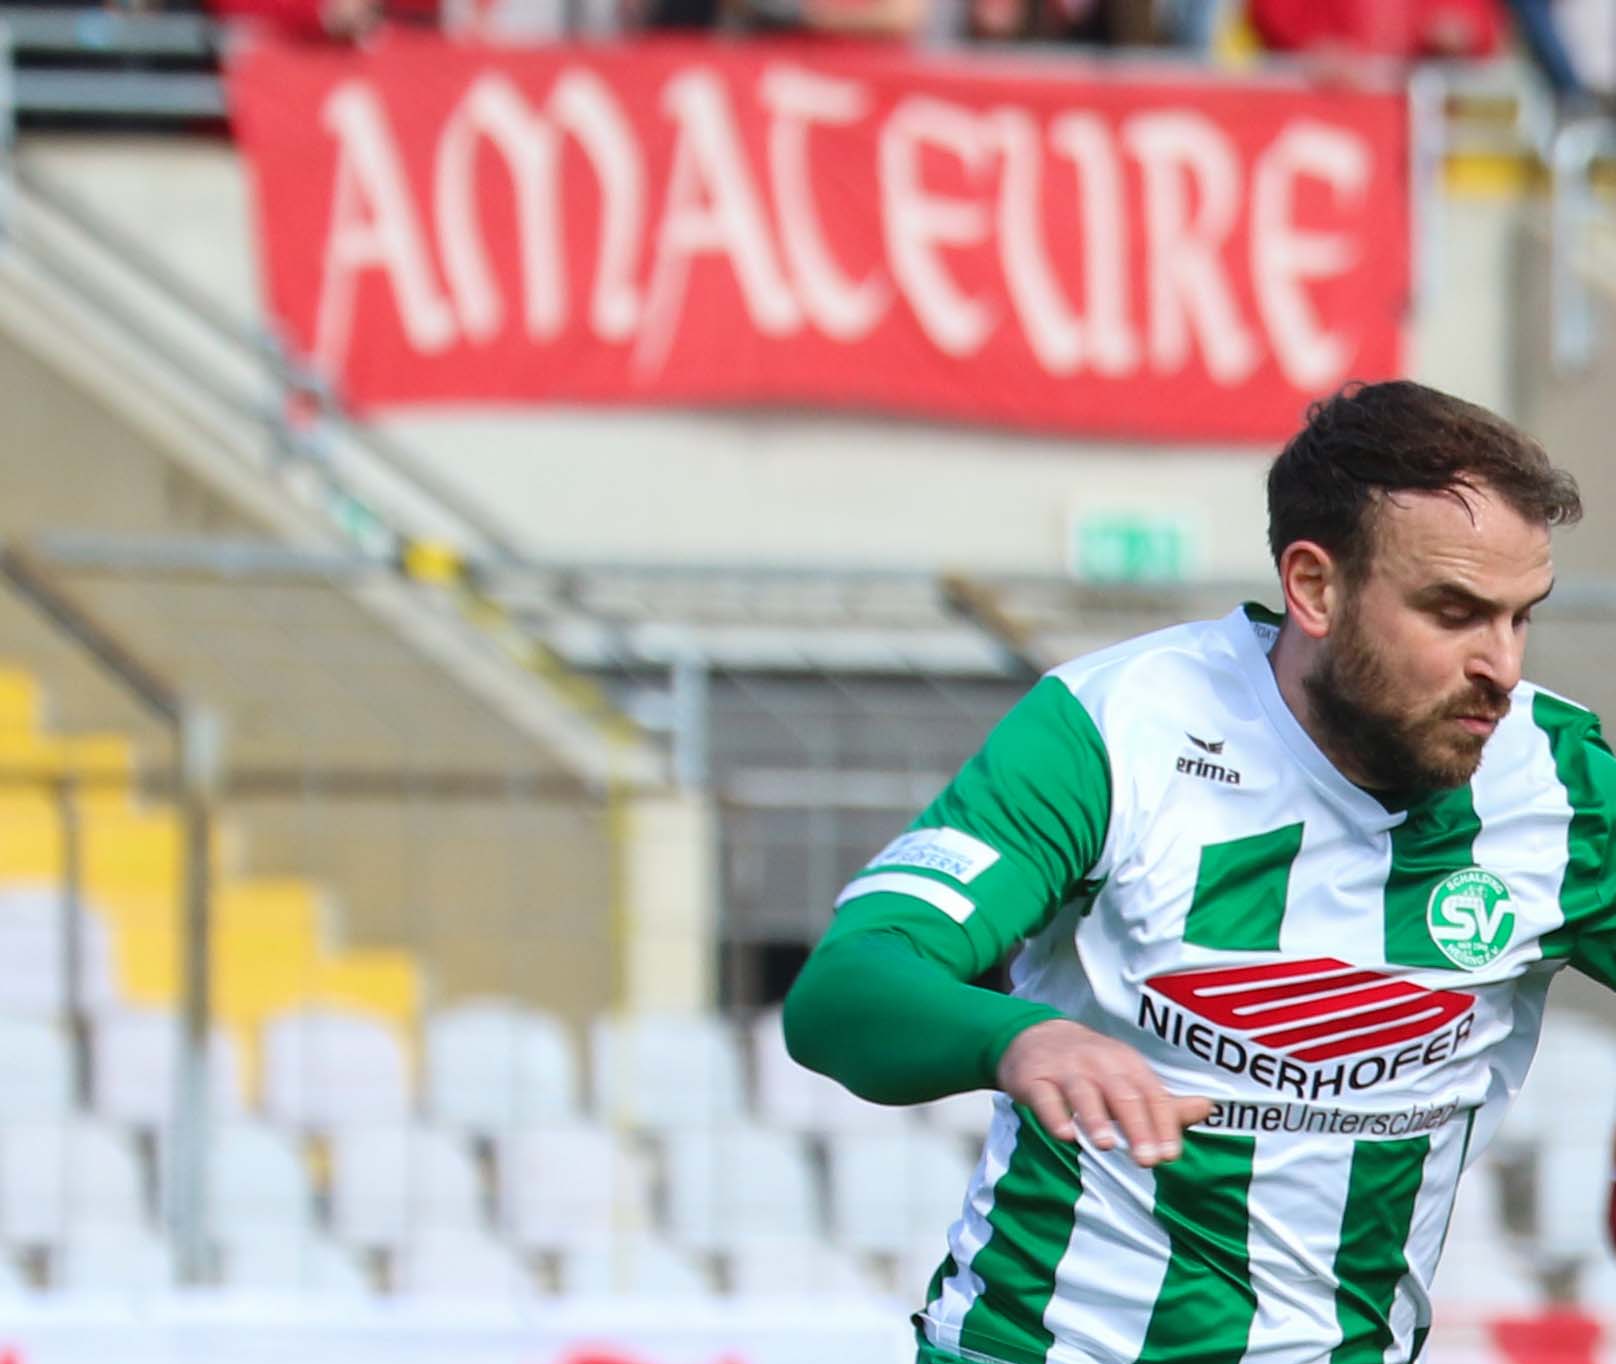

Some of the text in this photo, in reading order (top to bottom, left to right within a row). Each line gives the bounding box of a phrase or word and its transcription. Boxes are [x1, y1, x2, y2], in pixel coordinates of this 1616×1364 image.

[315, 68, 1372, 388] AMATEURE
[1176, 755, 1241, 785] erima
[1432, 894, 1516, 943] SV
[1138, 993, 1475, 1100] NIEDERHOFER
